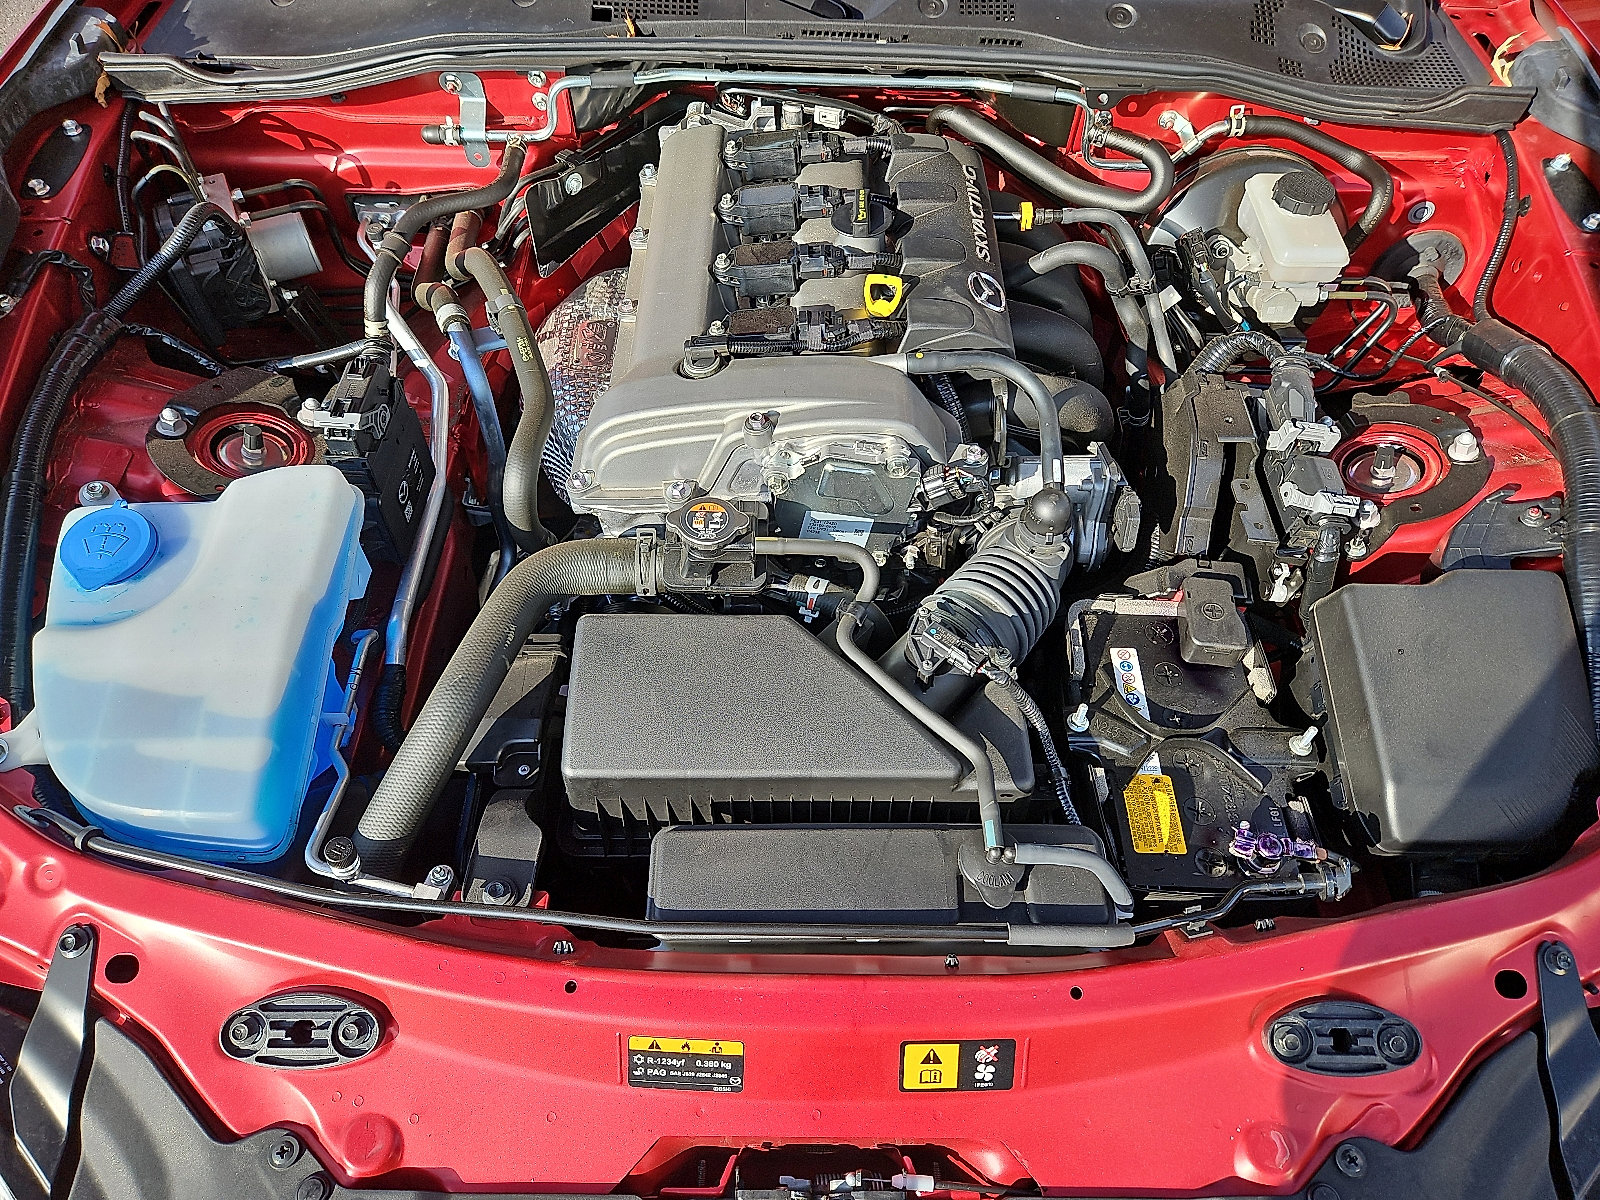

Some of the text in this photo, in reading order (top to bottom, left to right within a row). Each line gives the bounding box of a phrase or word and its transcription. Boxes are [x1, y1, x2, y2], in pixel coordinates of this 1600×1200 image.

[963, 164, 991, 262] SKYACTIV-G
[646, 1056, 686, 1067] R-1234yf
[720, 1060, 732, 1070] kg
[647, 1068, 667, 1077] PAG
